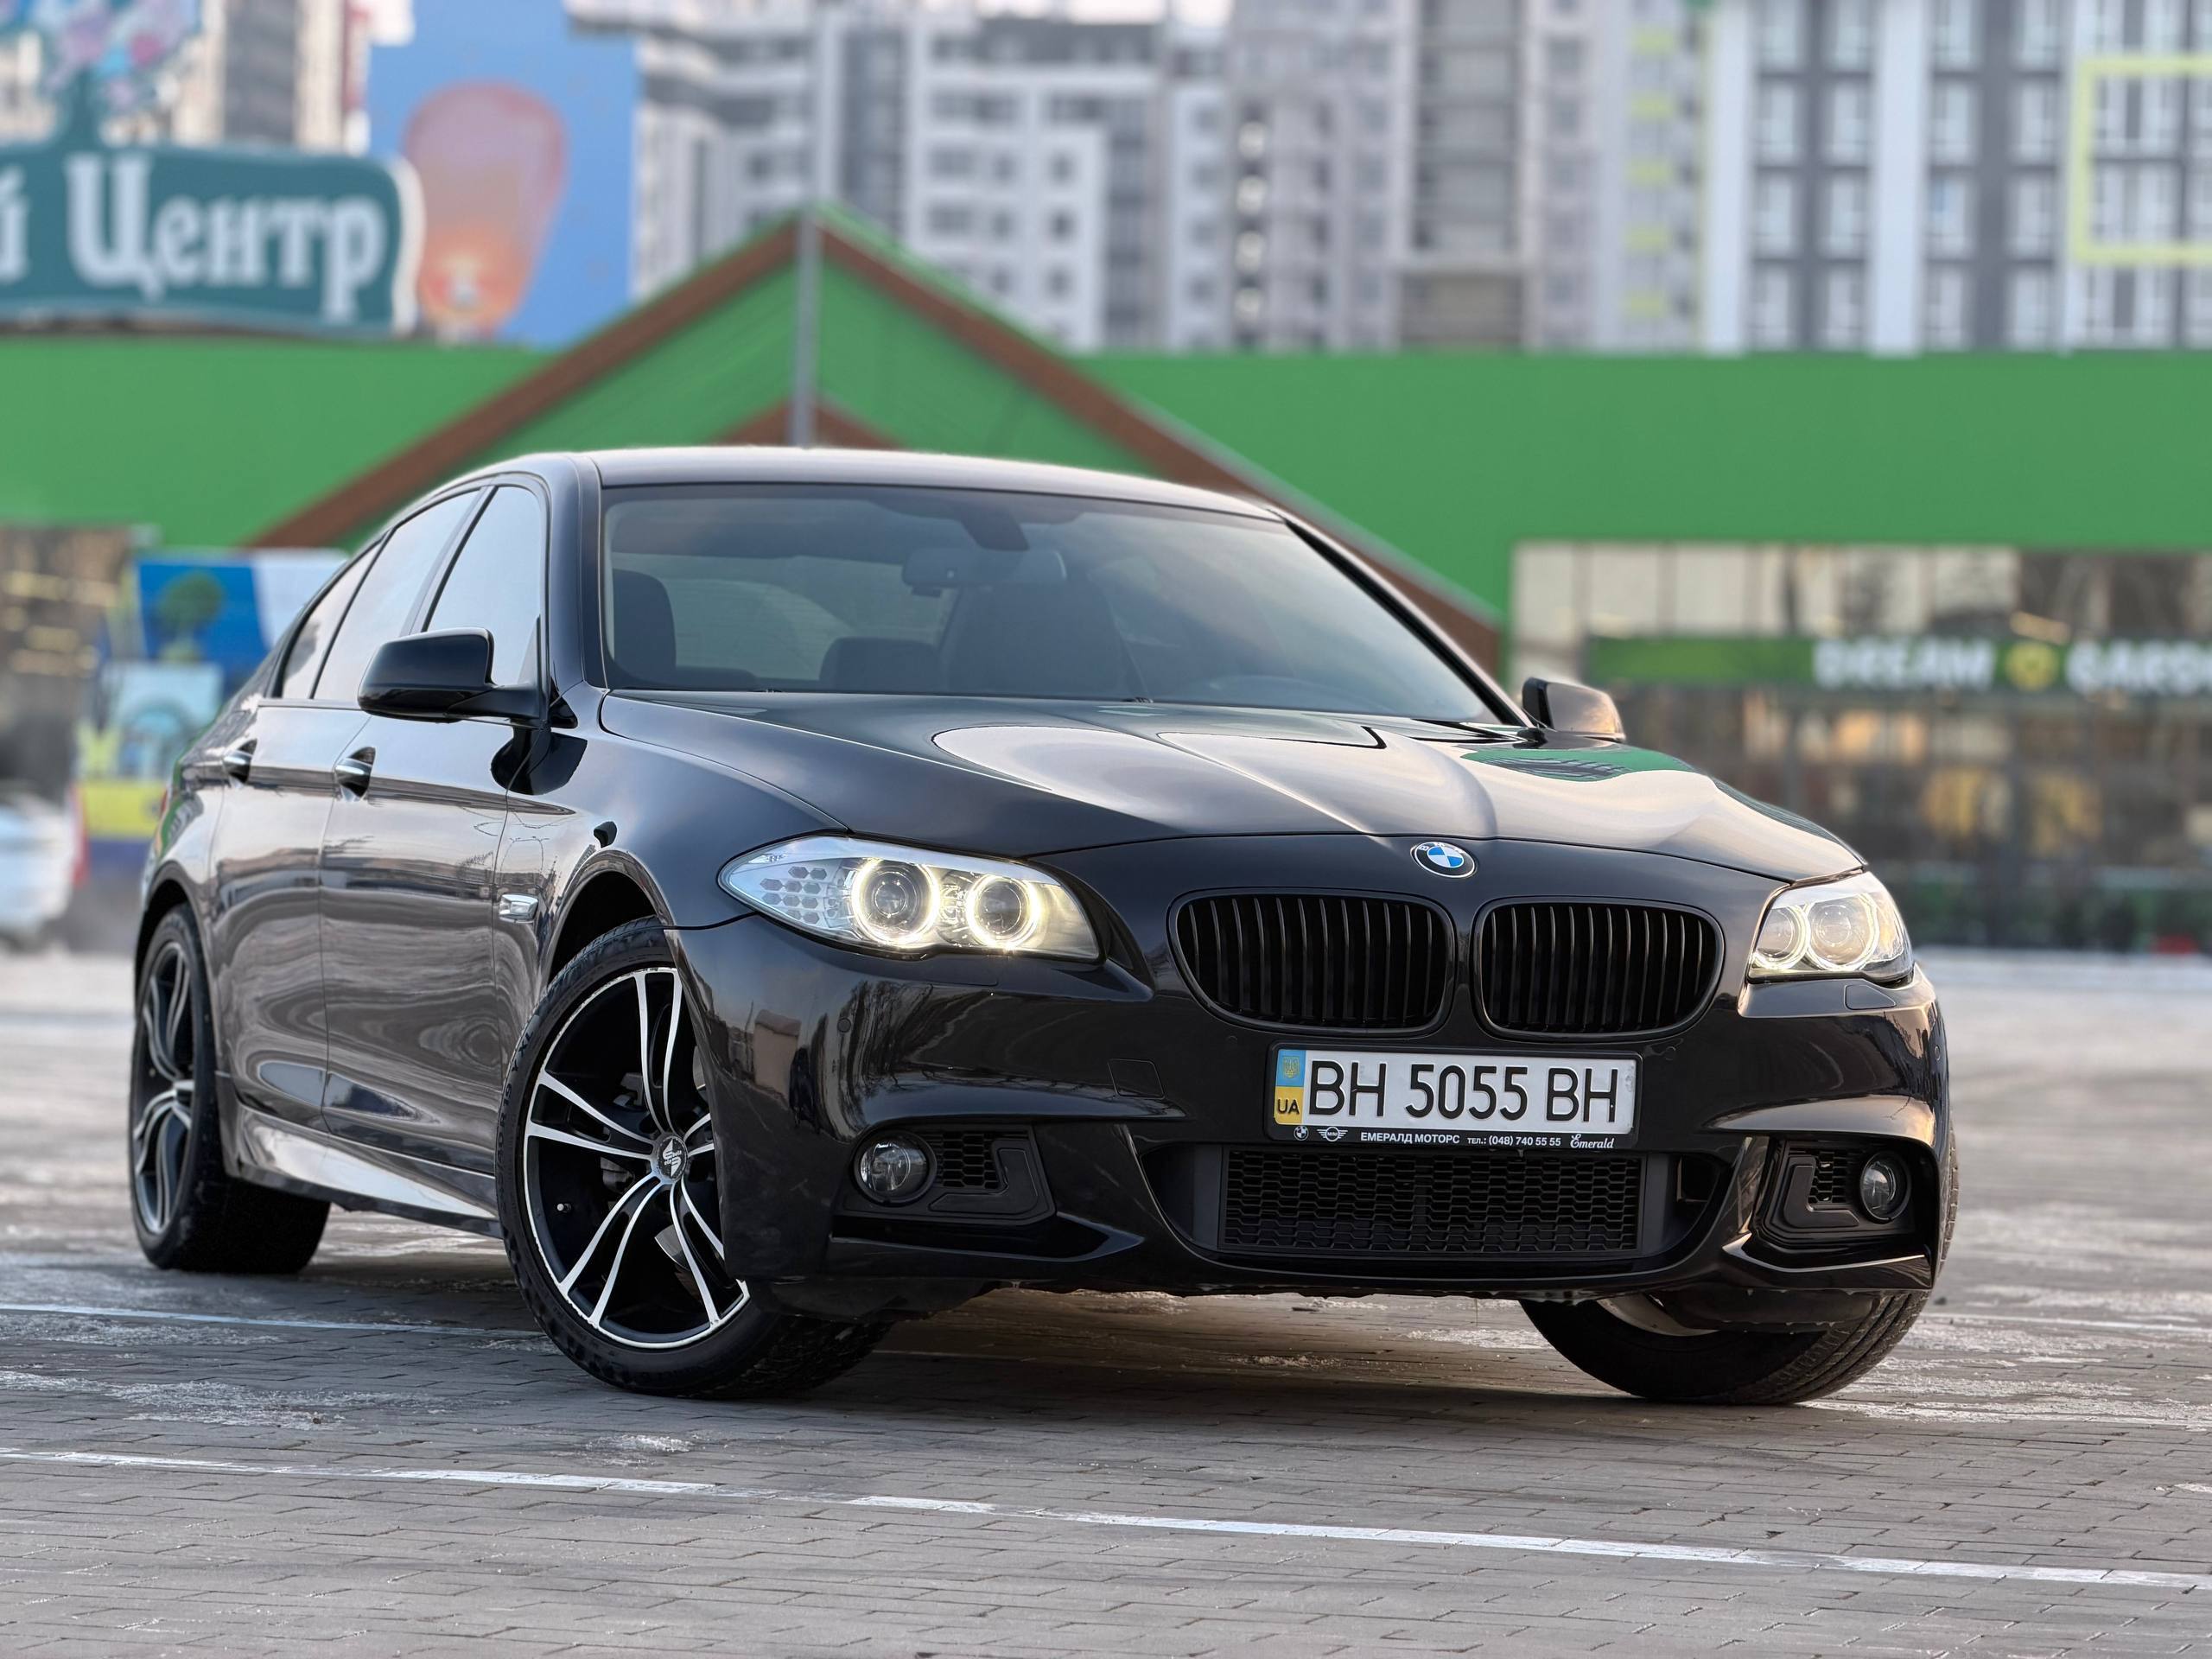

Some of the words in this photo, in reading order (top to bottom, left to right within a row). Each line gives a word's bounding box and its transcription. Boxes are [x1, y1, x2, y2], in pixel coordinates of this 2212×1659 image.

[66, 154, 385, 324] Центр
[1309, 1060, 1386, 1117] BH
[1406, 1064, 1527, 1121] 5055
[1547, 1068, 1618, 1122] BH
[1277, 1099, 1300, 1115] UA
[1360, 1132, 1413, 1143] ЕМЕРАЛД
[1414, 1134, 1460, 1144] МОТОРС
[1488, 1135, 1514, 1147] (048)
[1516, 1136, 1534, 1147] 740
[1535, 1137, 1548, 1147] 55
[1549, 1137, 1561, 1147] 55
[1570, 1134, 1614, 1148] Emerald
